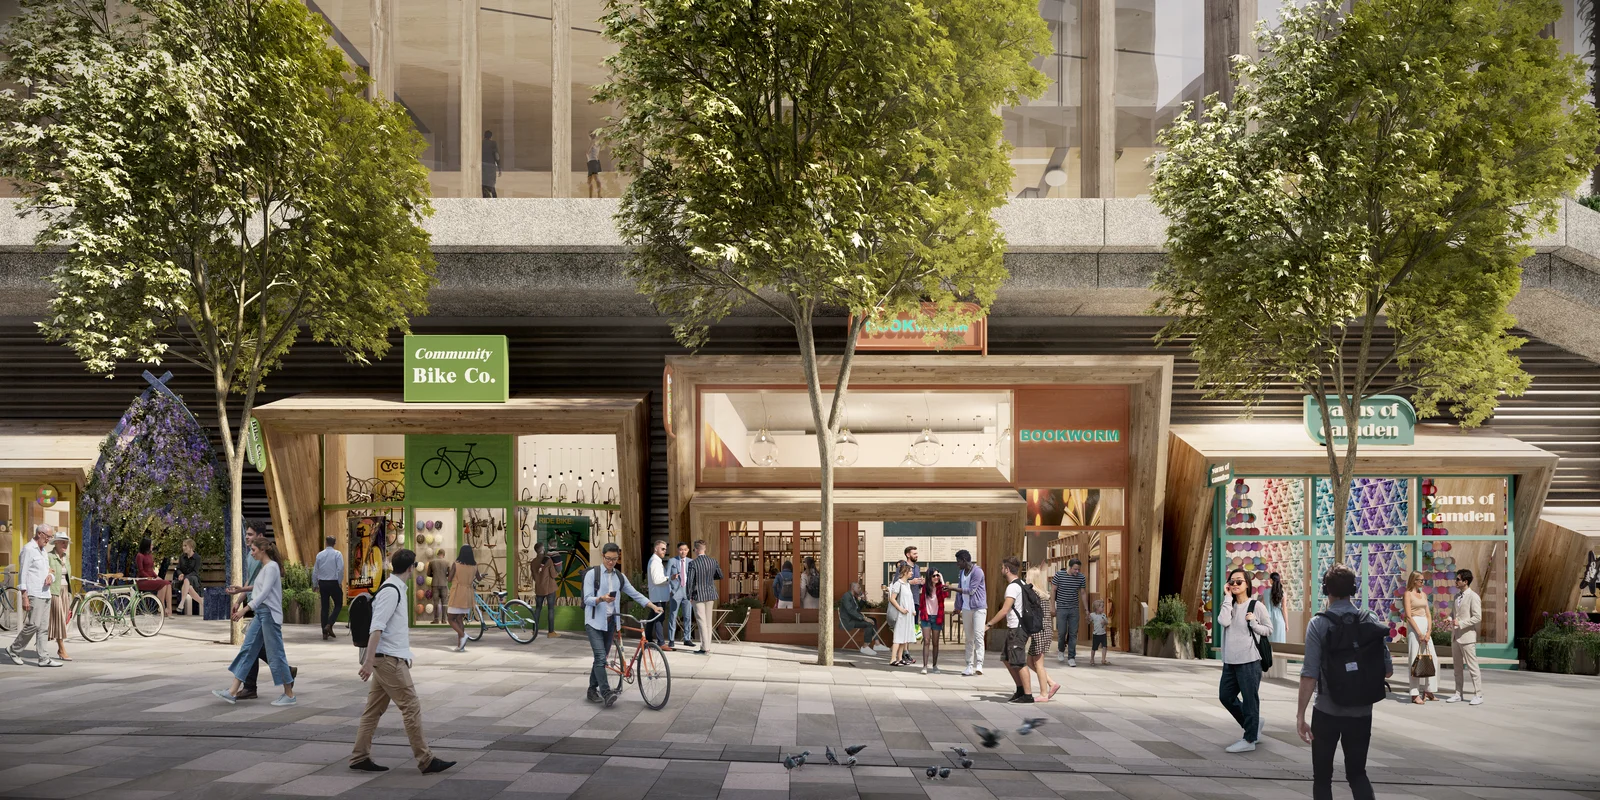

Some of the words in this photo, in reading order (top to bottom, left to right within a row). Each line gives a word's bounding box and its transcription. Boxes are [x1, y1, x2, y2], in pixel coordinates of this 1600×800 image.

[415, 348, 493, 362] Community
[412, 367, 457, 384] Bike
[464, 367, 496, 384] Co.
[1380, 403, 1399, 417] of
[1019, 429, 1120, 442] BOOKWORM
[1427, 495, 1475, 506] yarns
[1479, 493, 1495, 505] of
[1427, 511, 1495, 522] camden
